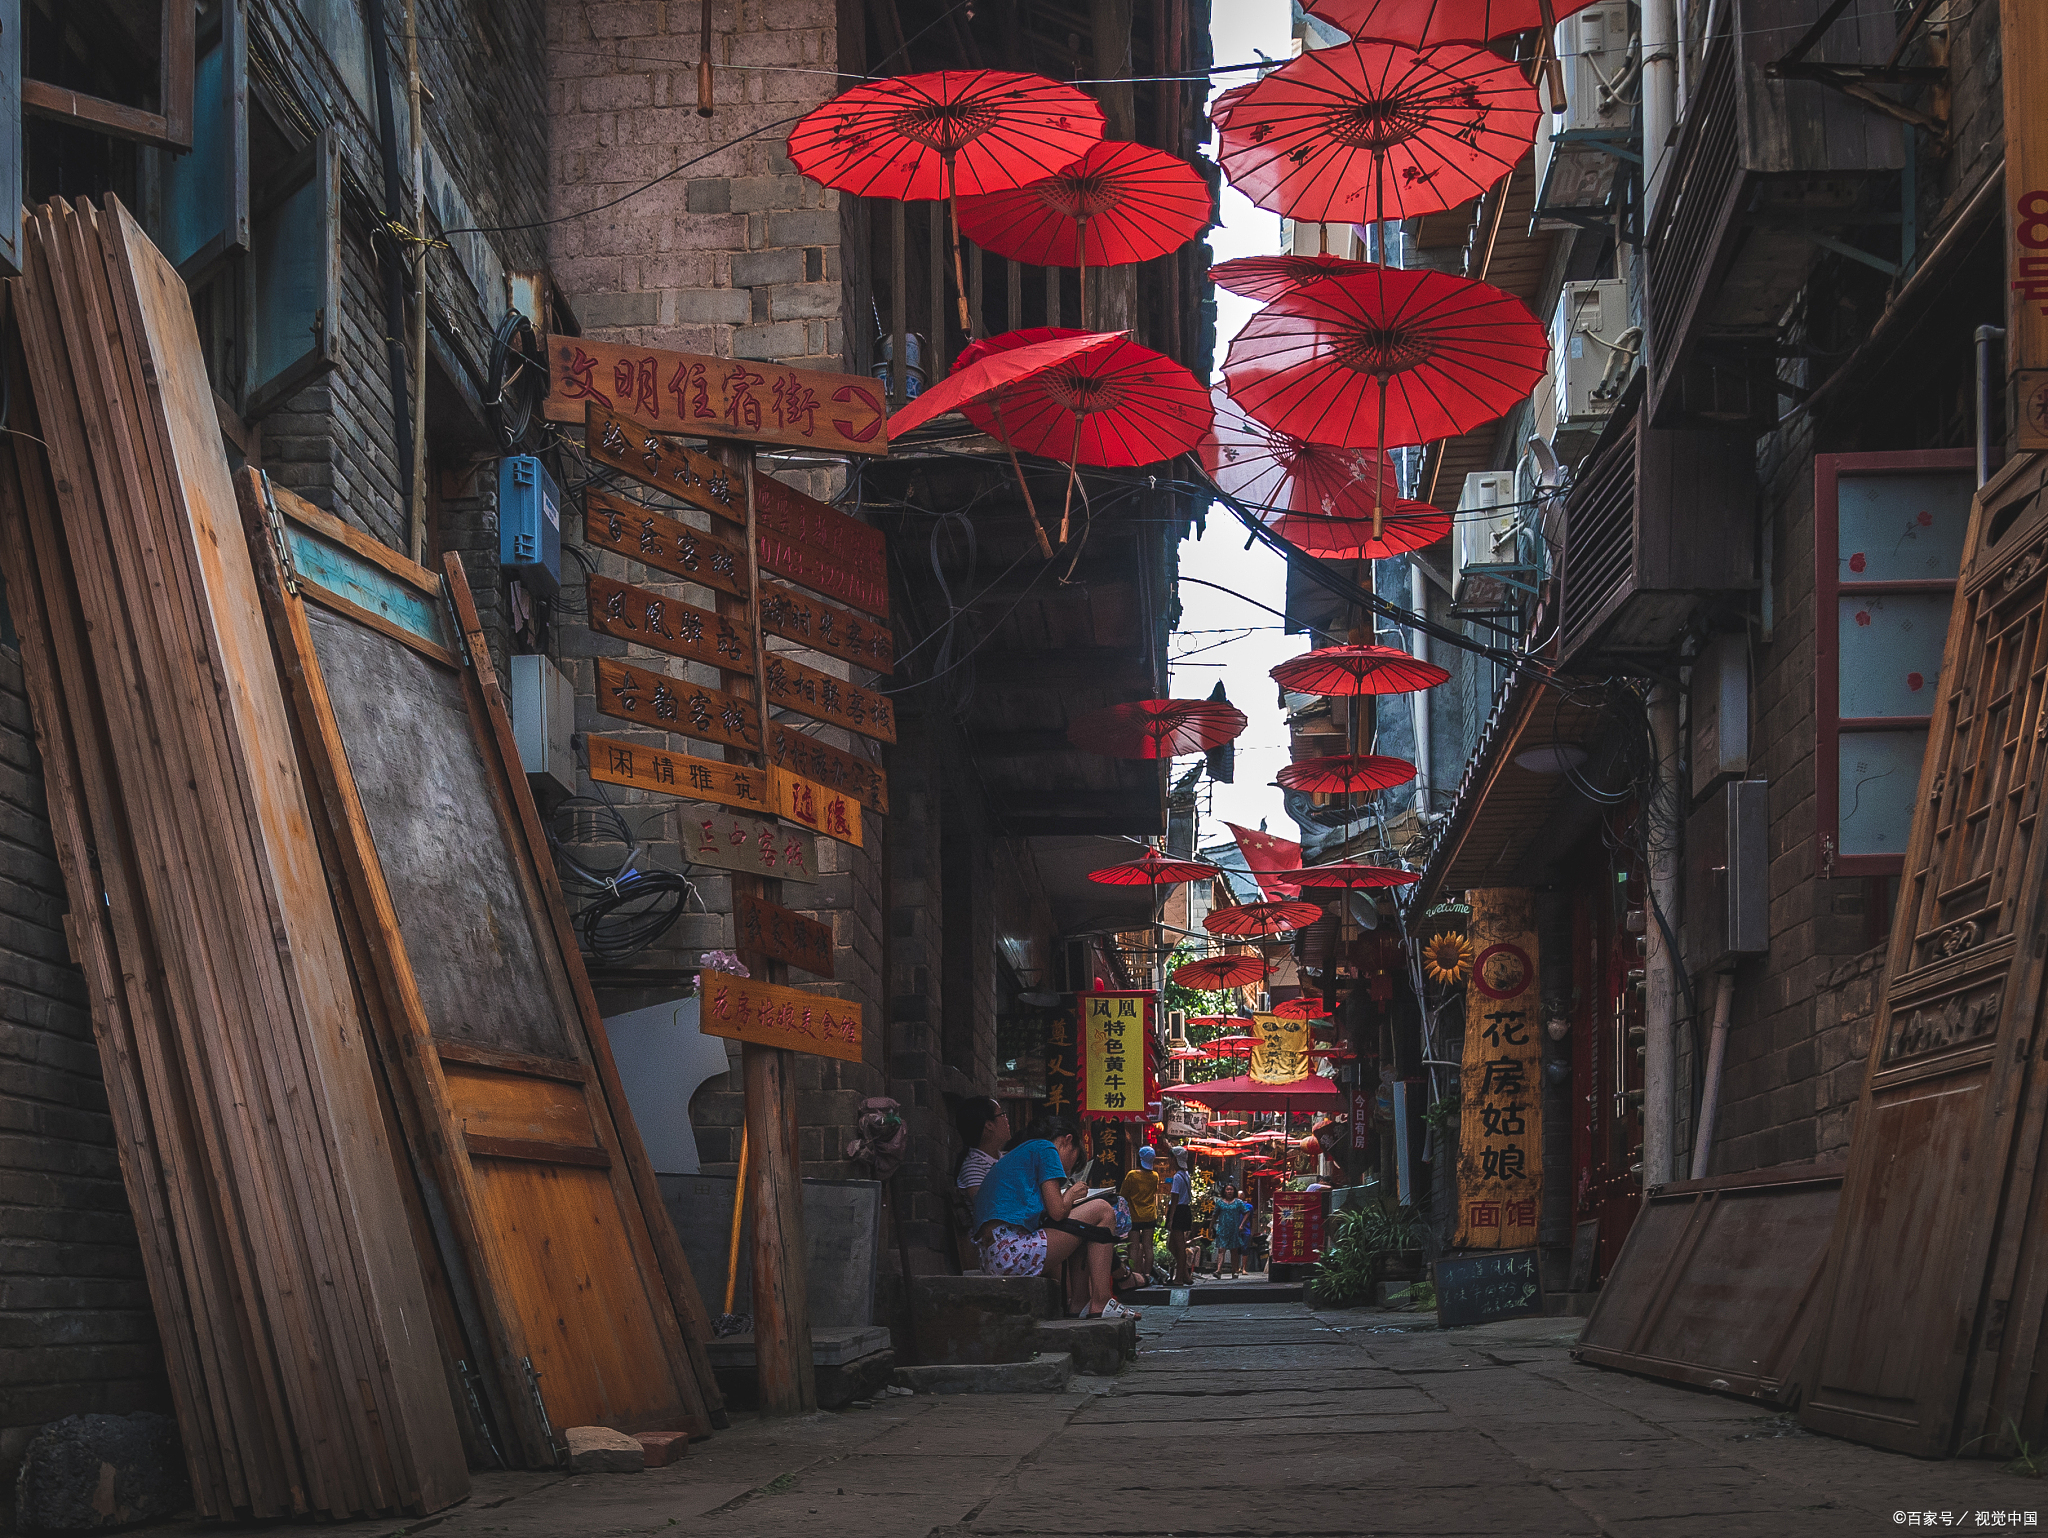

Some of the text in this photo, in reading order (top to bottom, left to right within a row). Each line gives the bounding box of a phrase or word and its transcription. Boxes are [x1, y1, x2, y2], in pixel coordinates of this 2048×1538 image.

[560, 346, 821, 437] 文明住宿街
[603, 589, 742, 661] 凤凰驿站
[611, 671, 756, 746] 古韵客栈
[608, 745, 757, 802] 闲情雅筑
[712, 985, 858, 1044] 花房姑娘美食馆
[1092, 998, 1137, 1019] 凤凰
[1103, 1020, 1126, 1108] 特色黄牛粉
[1480, 1010, 1530, 1181] 花房姑娘
[1354, 1094, 1366, 1149] 今日有房
[1469, 1199, 1537, 1228] 面馆
